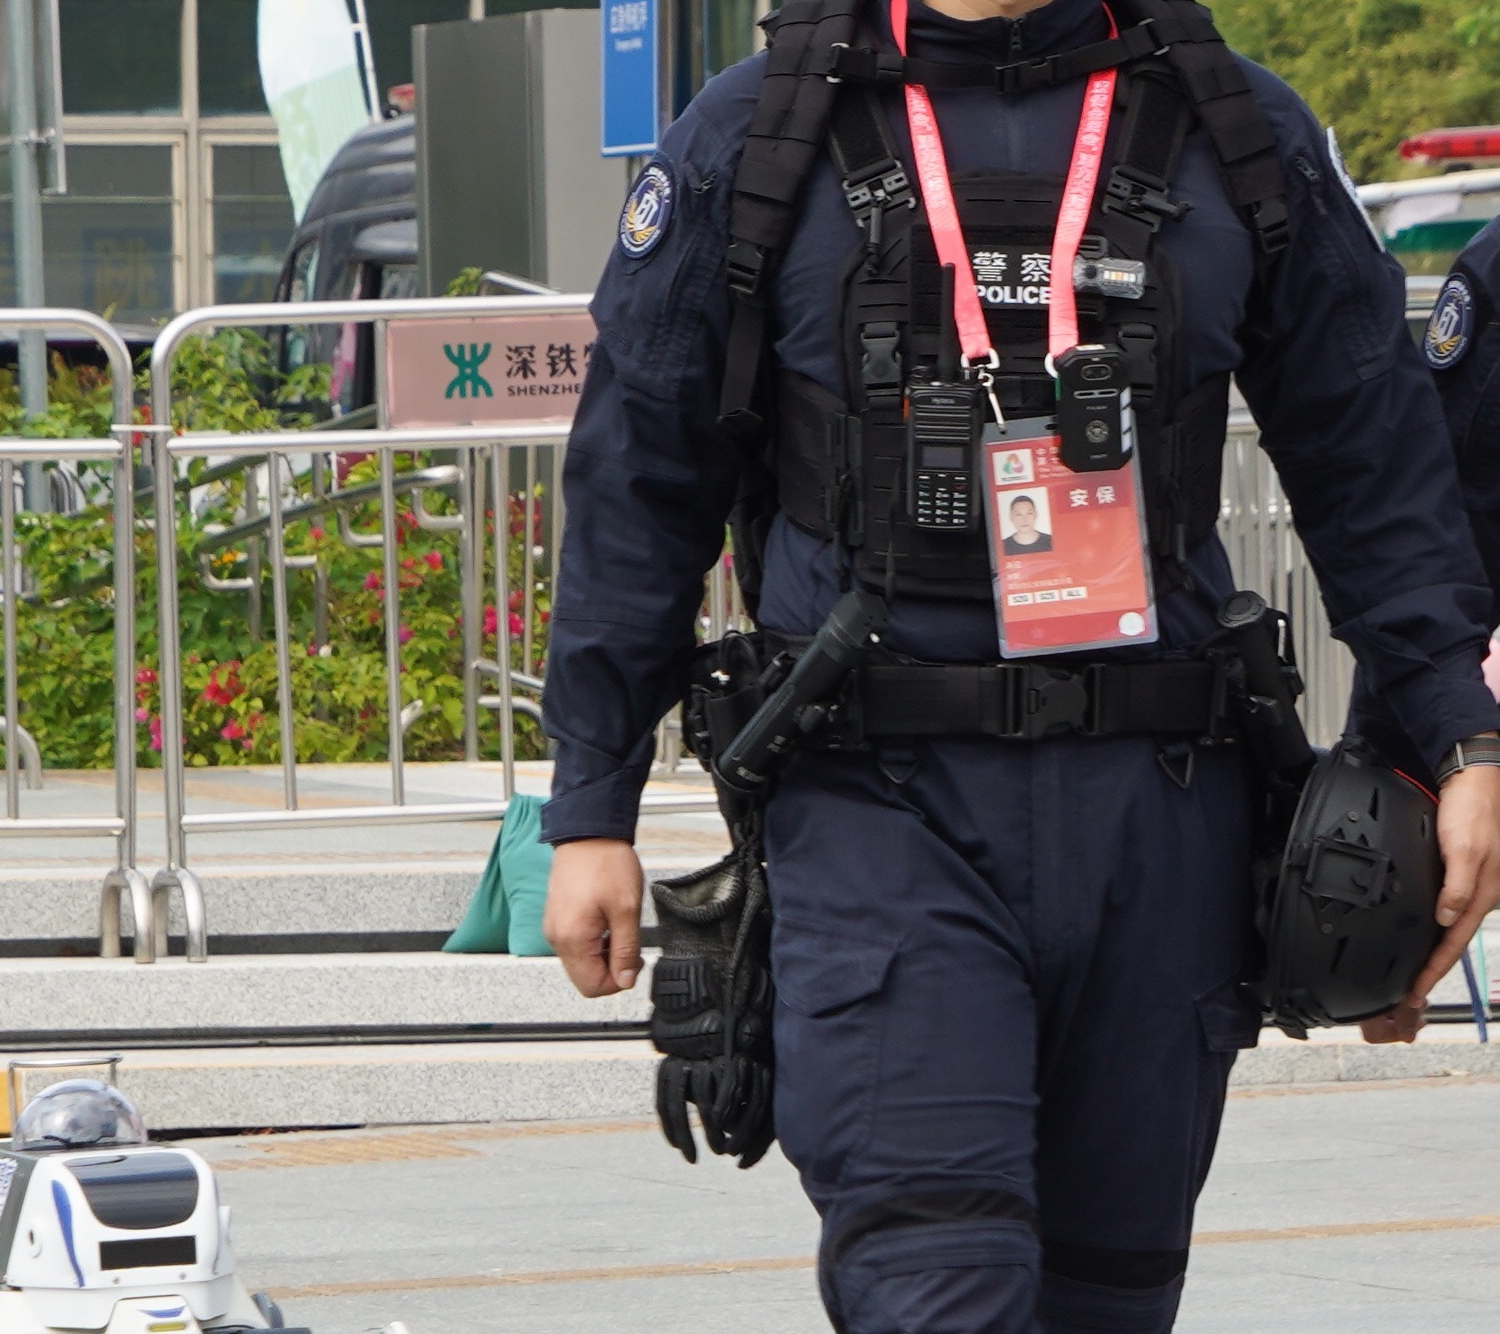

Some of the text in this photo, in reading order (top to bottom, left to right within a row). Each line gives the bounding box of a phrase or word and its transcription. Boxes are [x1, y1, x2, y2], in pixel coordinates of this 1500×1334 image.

[973, 252, 1052, 282] 警察
[975, 285, 1052, 304] POLICE
[506, 343, 594, 379] 深铁
[507, 384, 581, 396] SHENZHE
[1069, 485, 1116, 507] 安保
